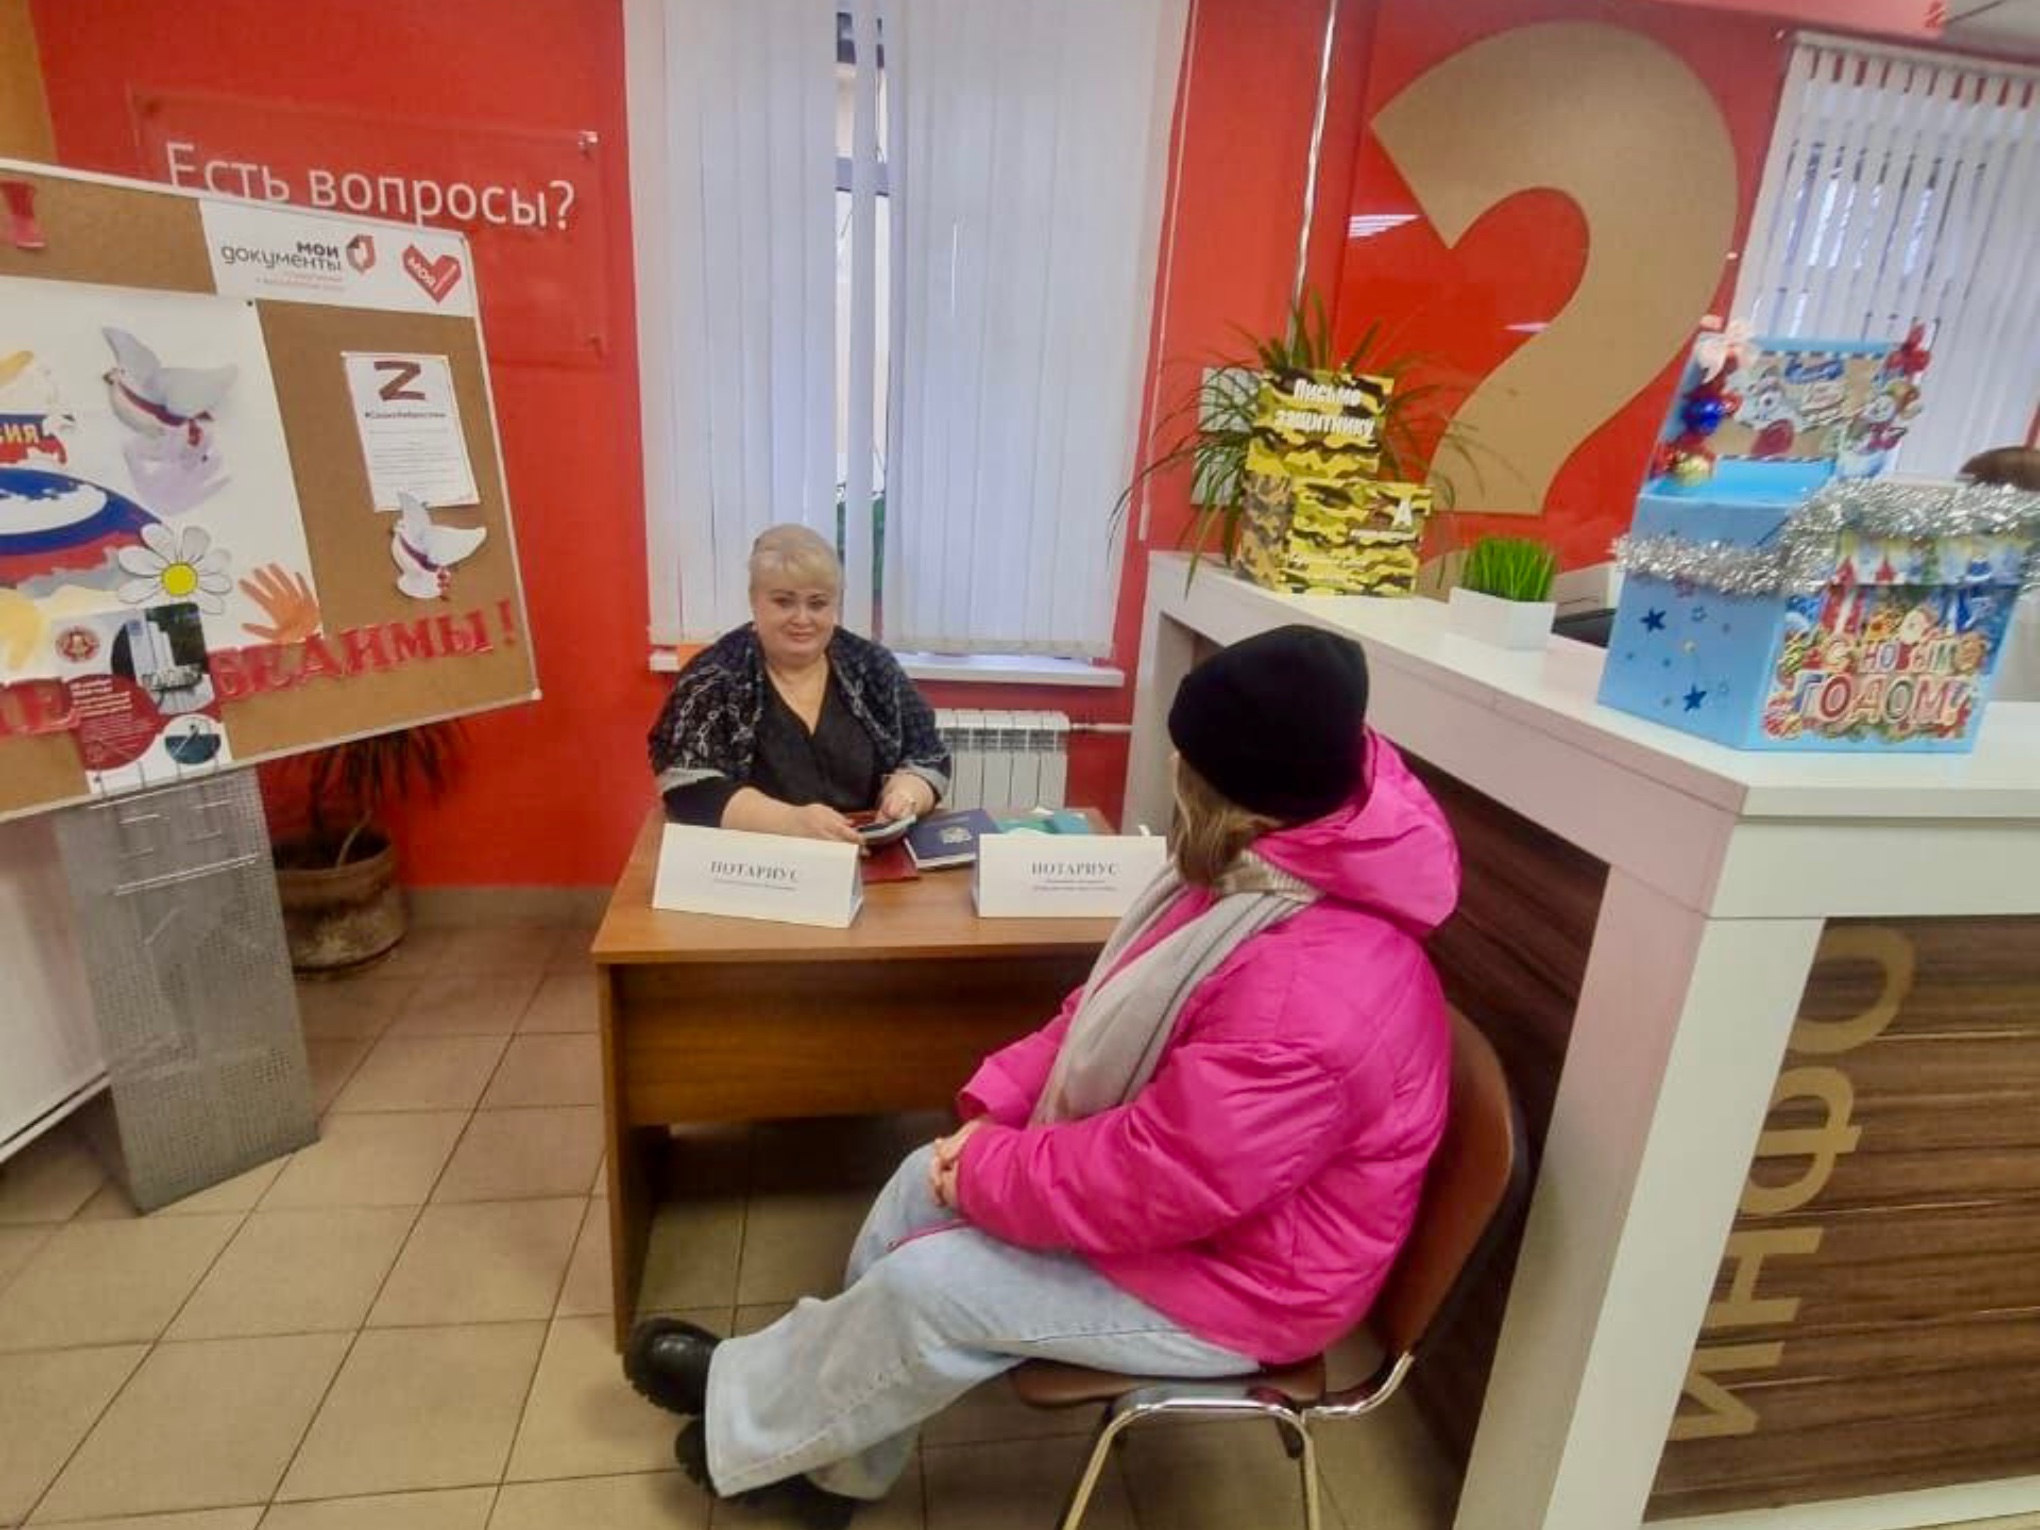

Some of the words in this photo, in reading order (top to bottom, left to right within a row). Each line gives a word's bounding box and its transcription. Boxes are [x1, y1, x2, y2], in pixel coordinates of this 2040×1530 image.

[166, 142, 291, 201] Есть
[308, 170, 576, 231] вопросы?
[221, 245, 342, 270] документы
[711, 861, 797, 881] НОТАРИУС
[1031, 861, 1118, 877] НОТАРИУС
